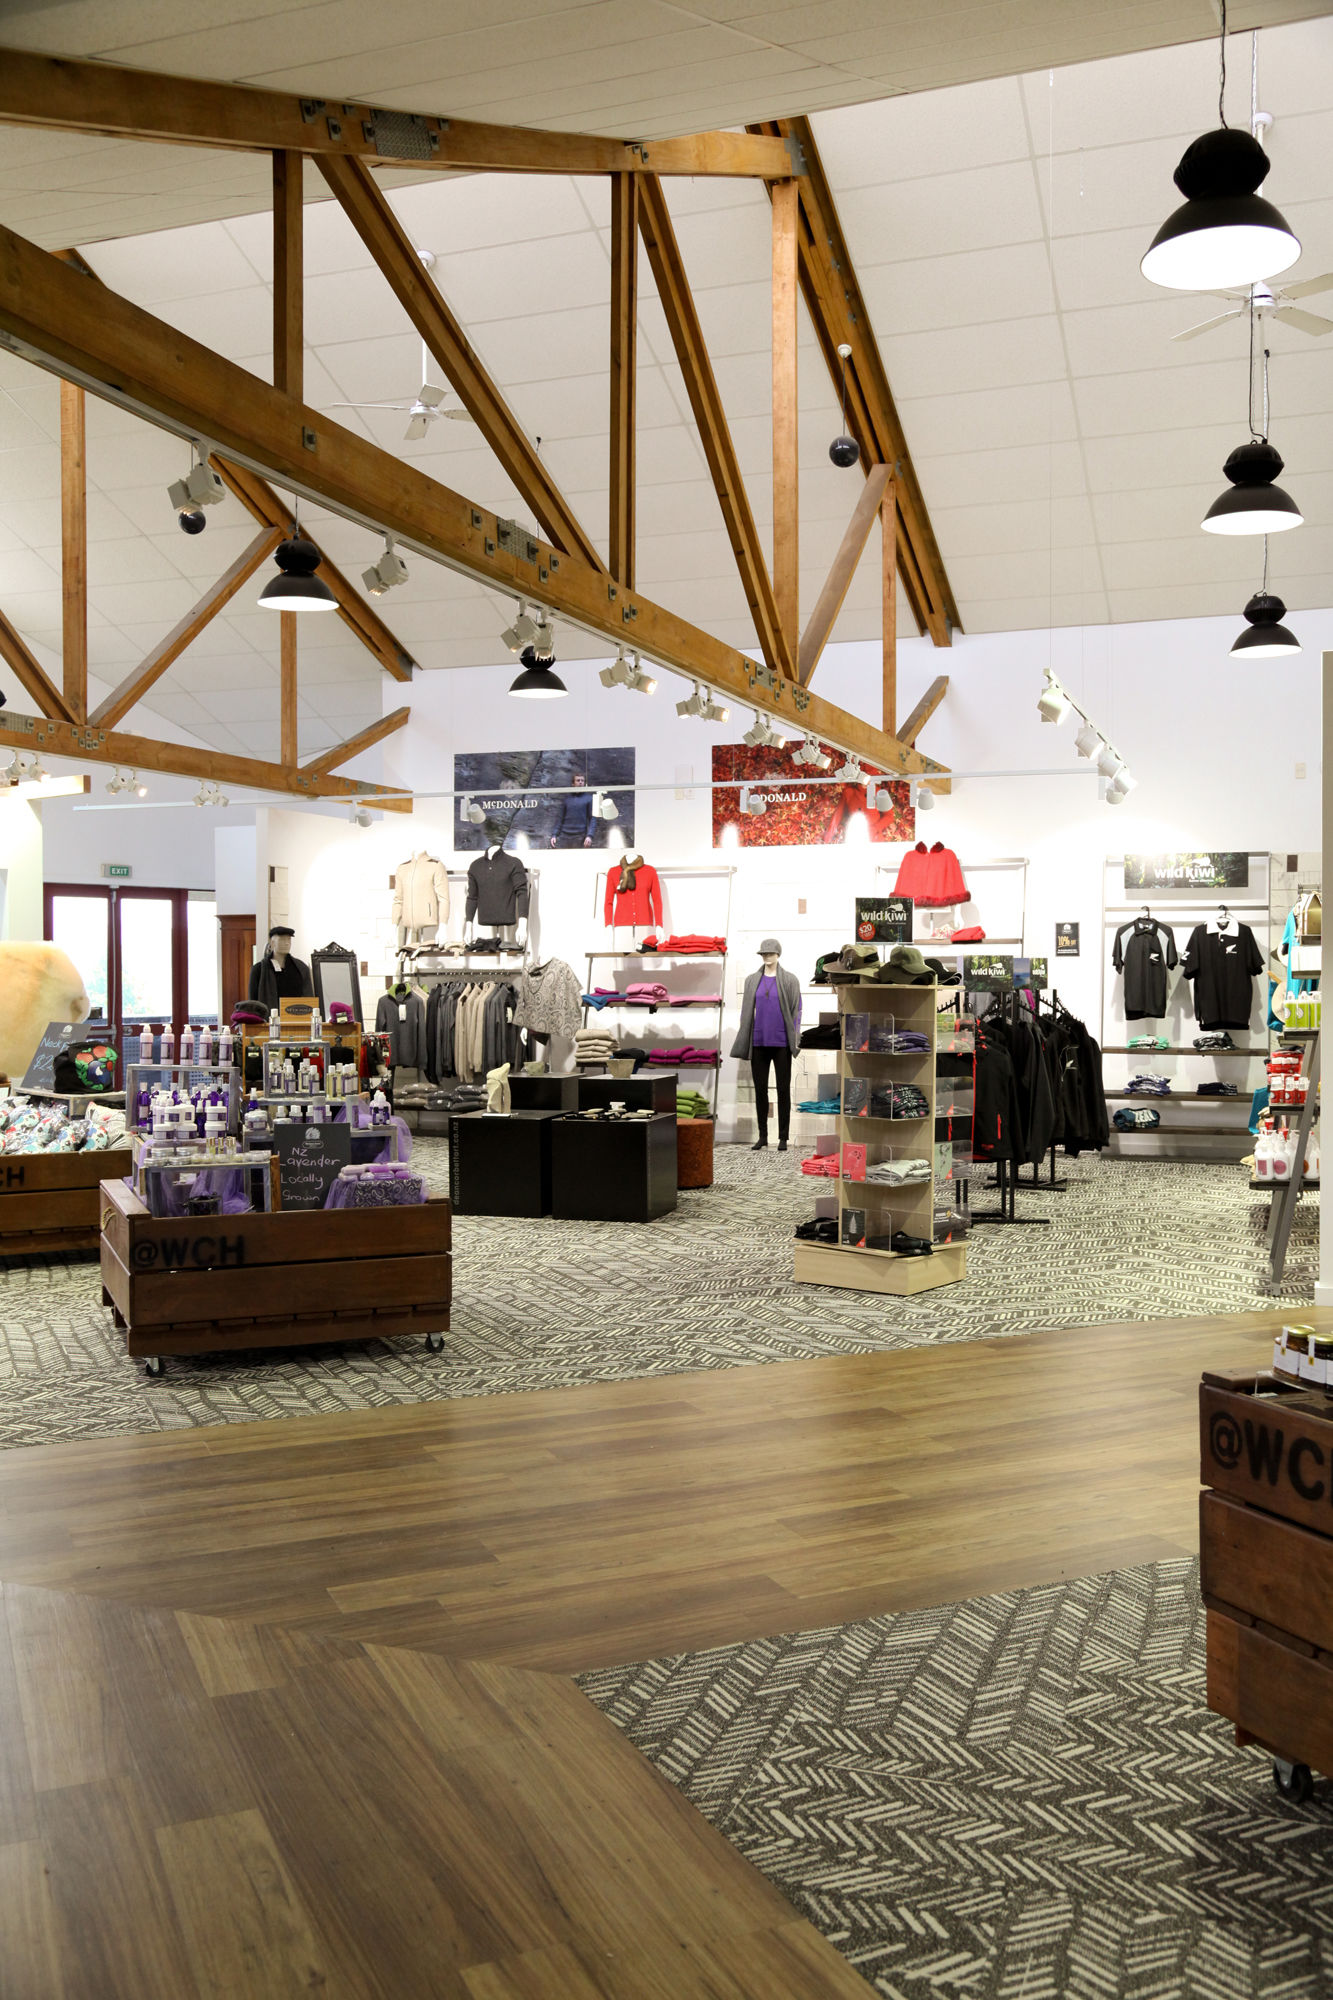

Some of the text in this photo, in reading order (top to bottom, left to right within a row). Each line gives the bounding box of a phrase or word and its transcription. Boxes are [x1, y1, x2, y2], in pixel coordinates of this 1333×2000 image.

[760, 792, 807, 803] DONALD
[111, 867, 128, 875] EXIT
[1154, 866, 1215, 880] wild kiwi
[861, 910, 907, 922] wild kiwi
[859, 923, 873, 934] $20
[970, 967, 1006, 978] wild kiwi
[33, 1054, 54, 1070] $2
[291, 1147, 308, 1157] NZ
[0, 1165, 25, 1188] H
[280, 1173, 323, 1190] Locally
[132, 1235, 246, 1268] @WCH
[1208, 1410, 1333, 1503] @WC
